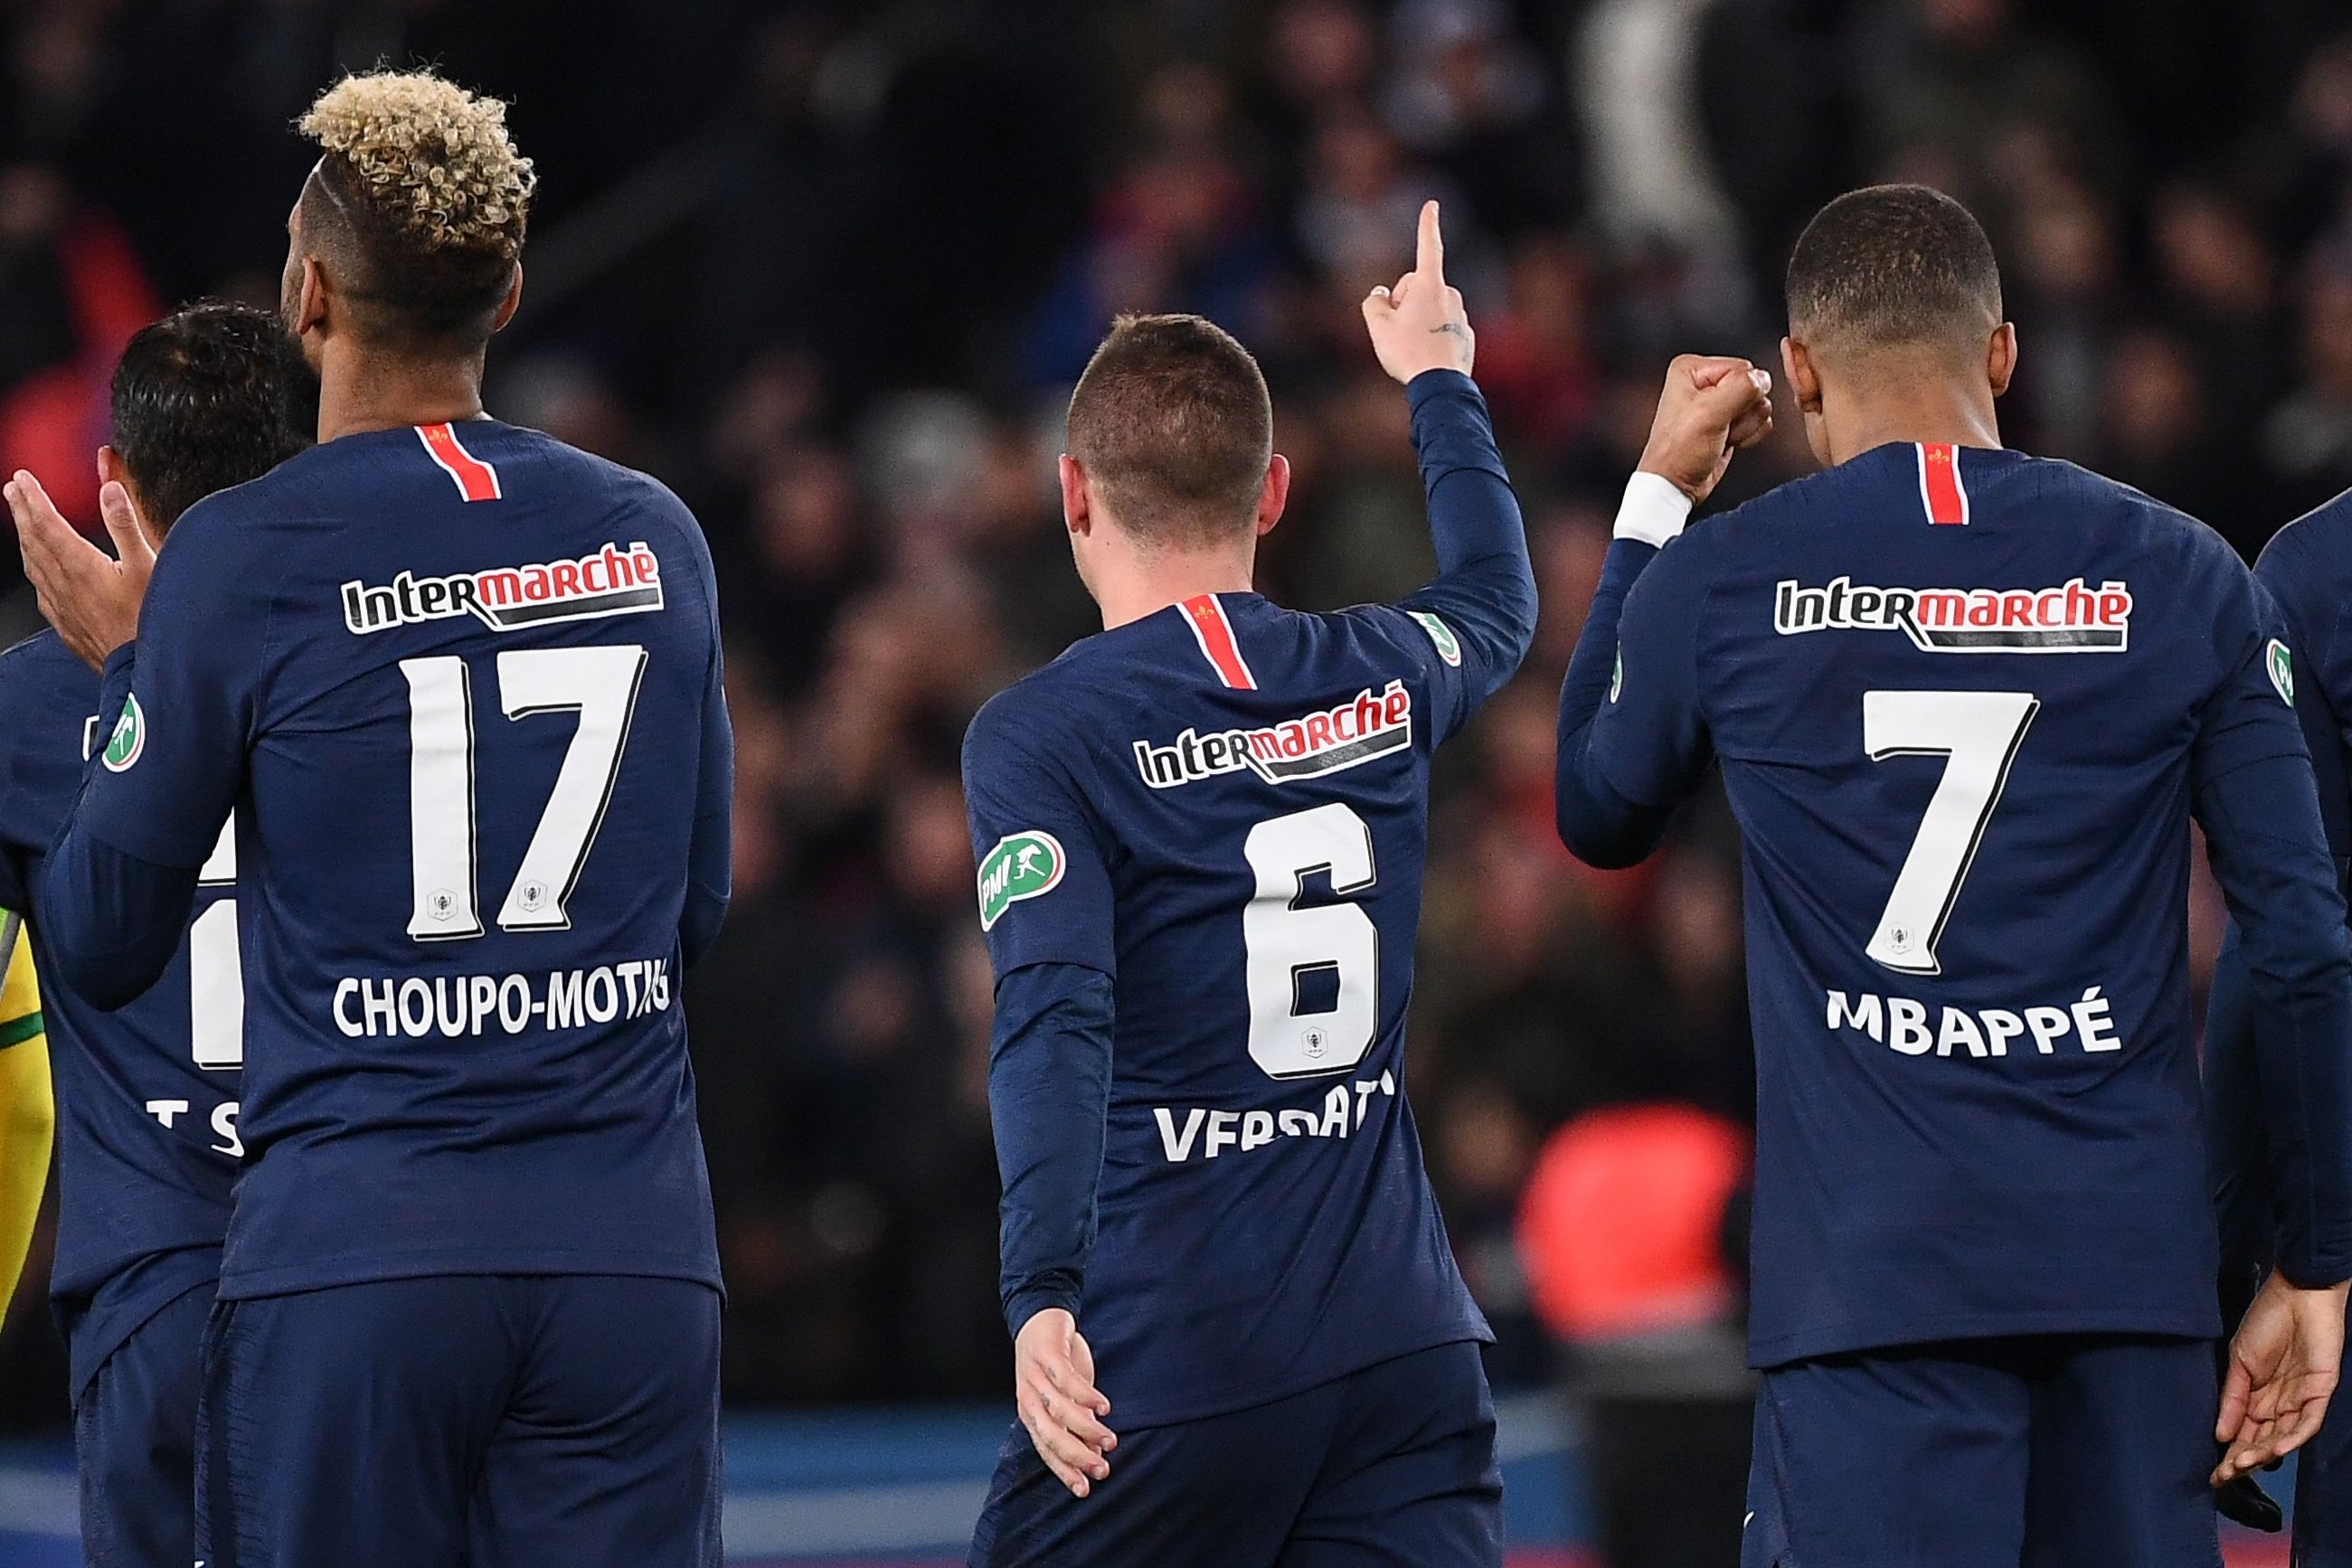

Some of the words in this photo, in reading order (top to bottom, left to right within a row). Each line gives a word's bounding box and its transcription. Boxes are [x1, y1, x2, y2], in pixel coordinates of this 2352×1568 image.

[399, 645, 648, 941] 17
[1863, 691, 2041, 975] 7
[1244, 802, 1379, 1081] 6
[1827, 986, 2122, 1057] MBAPPÉ
